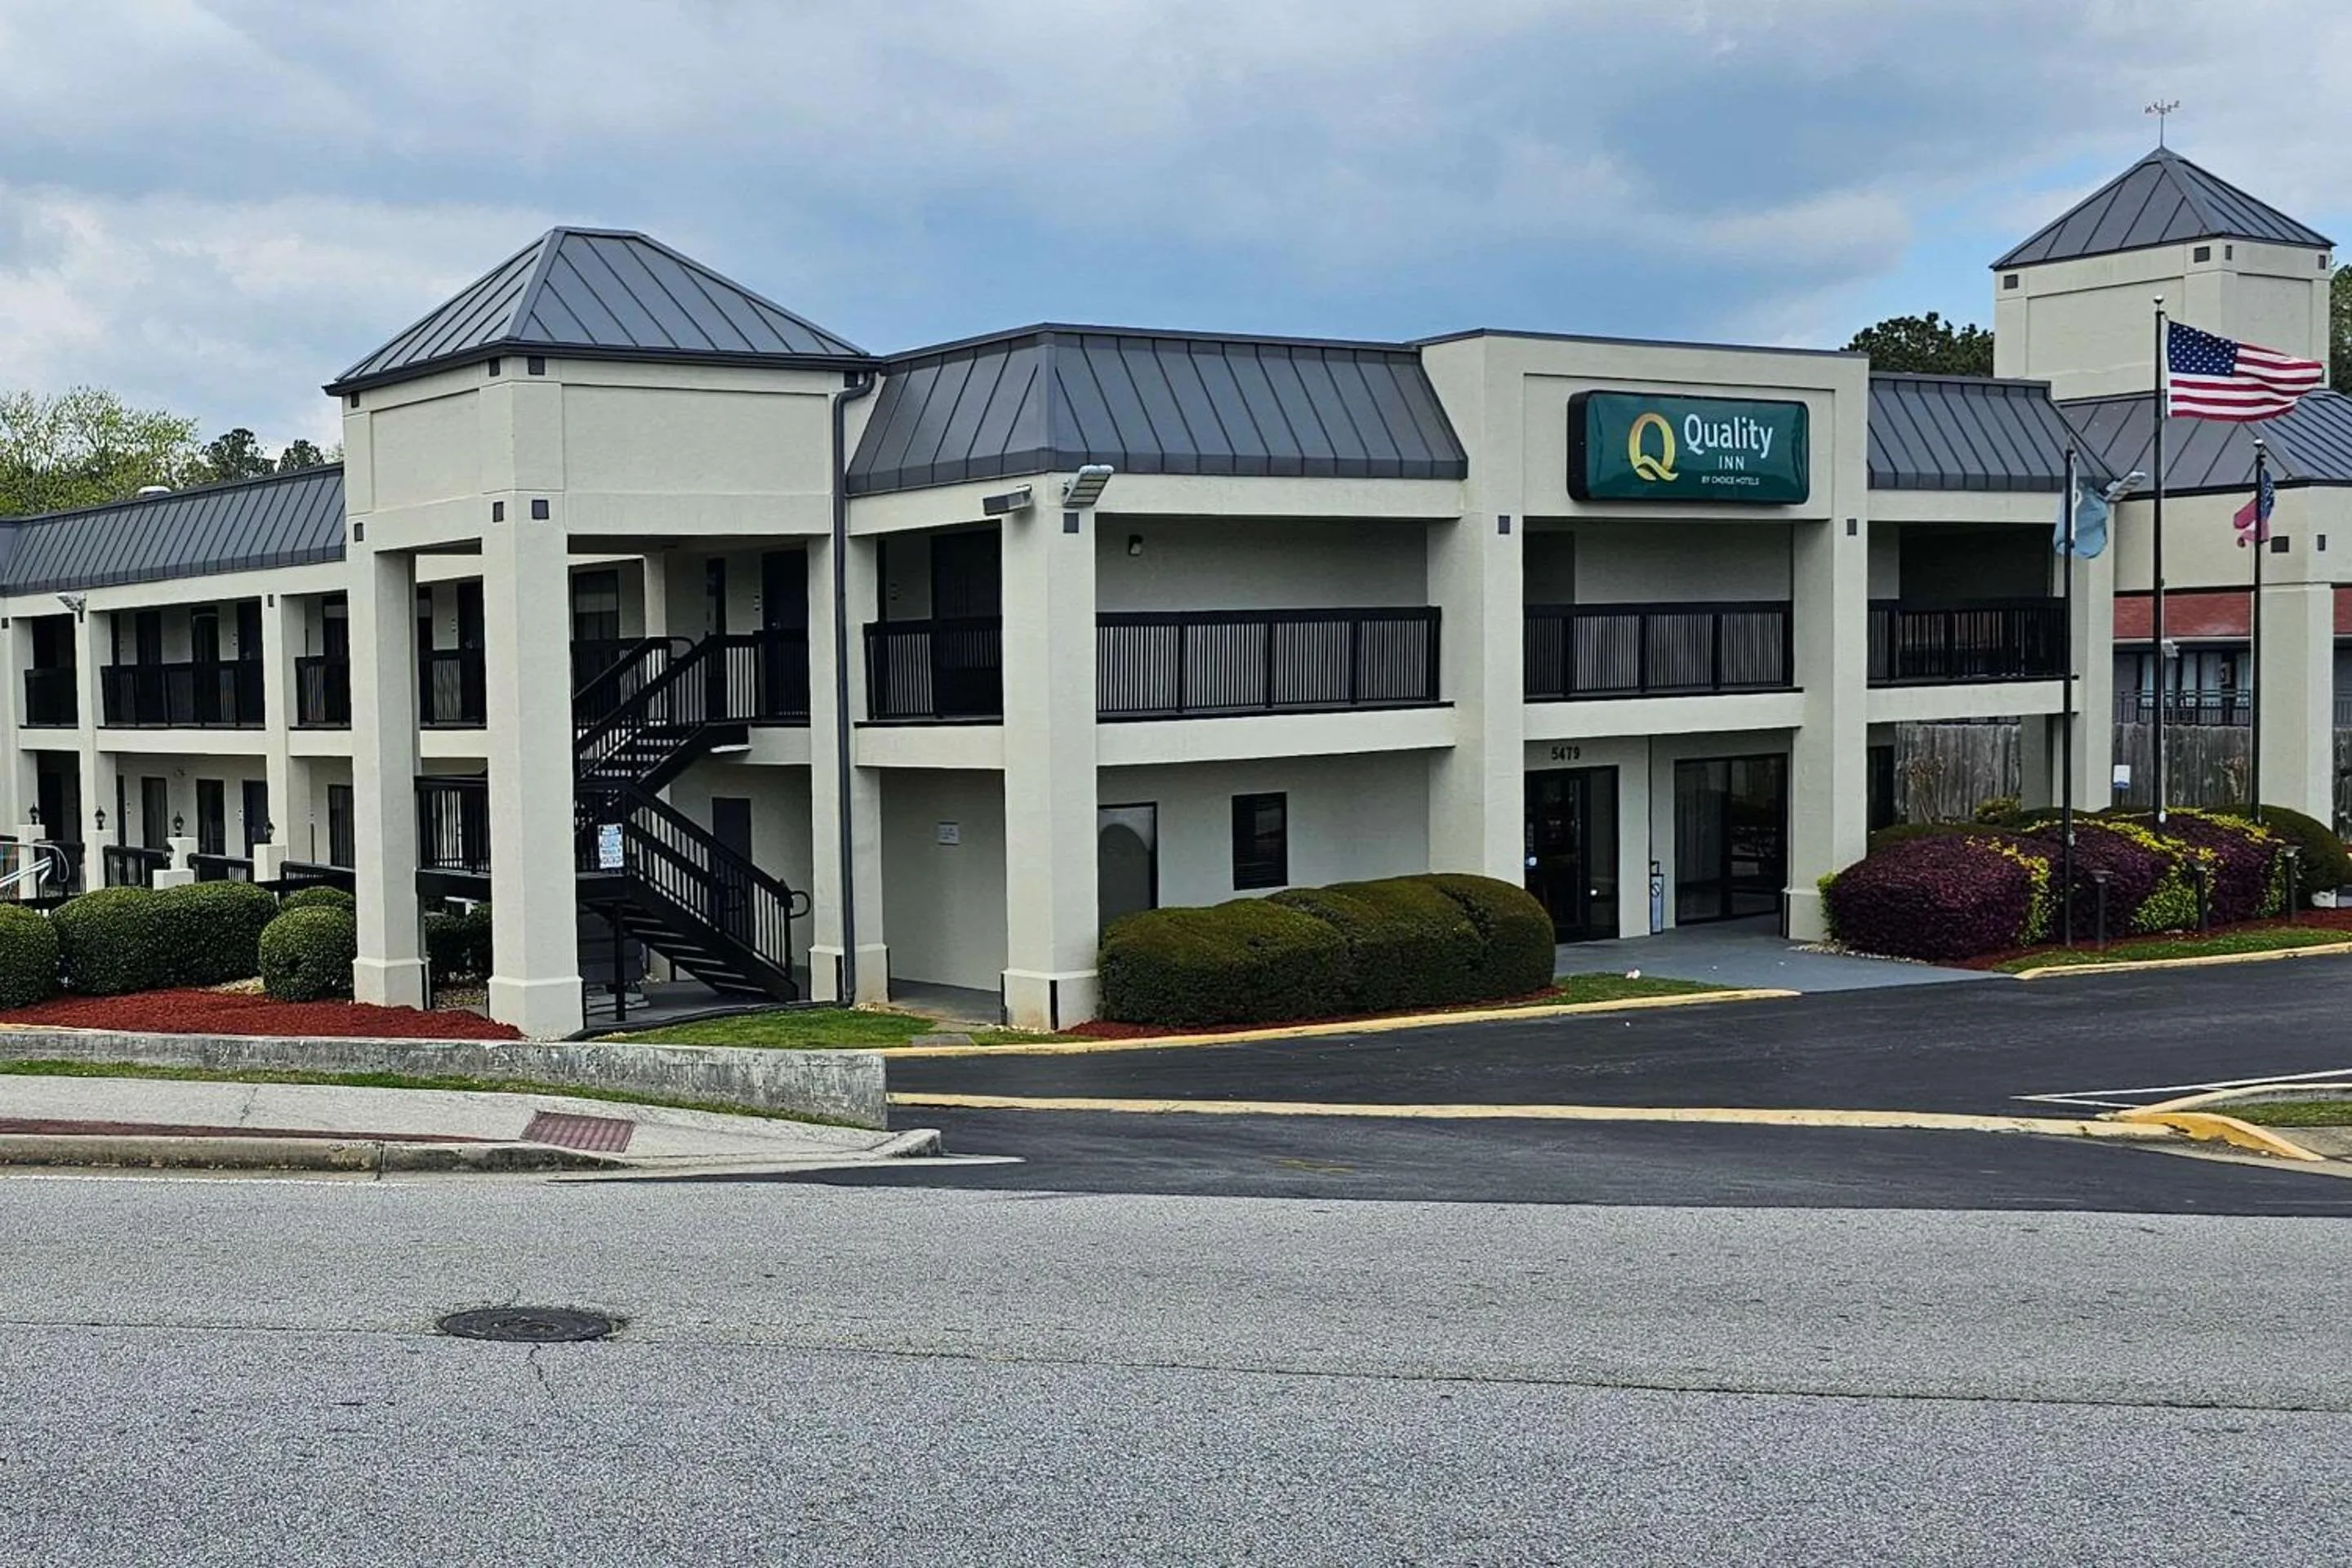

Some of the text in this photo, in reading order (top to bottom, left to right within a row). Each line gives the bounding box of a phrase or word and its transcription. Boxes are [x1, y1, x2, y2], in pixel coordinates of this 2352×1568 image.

[1628, 412, 1678, 481] Q
[1684, 413, 1773, 459] Quality
[1718, 455, 1744, 470] INN
[1551, 746, 1580, 760] 5479
